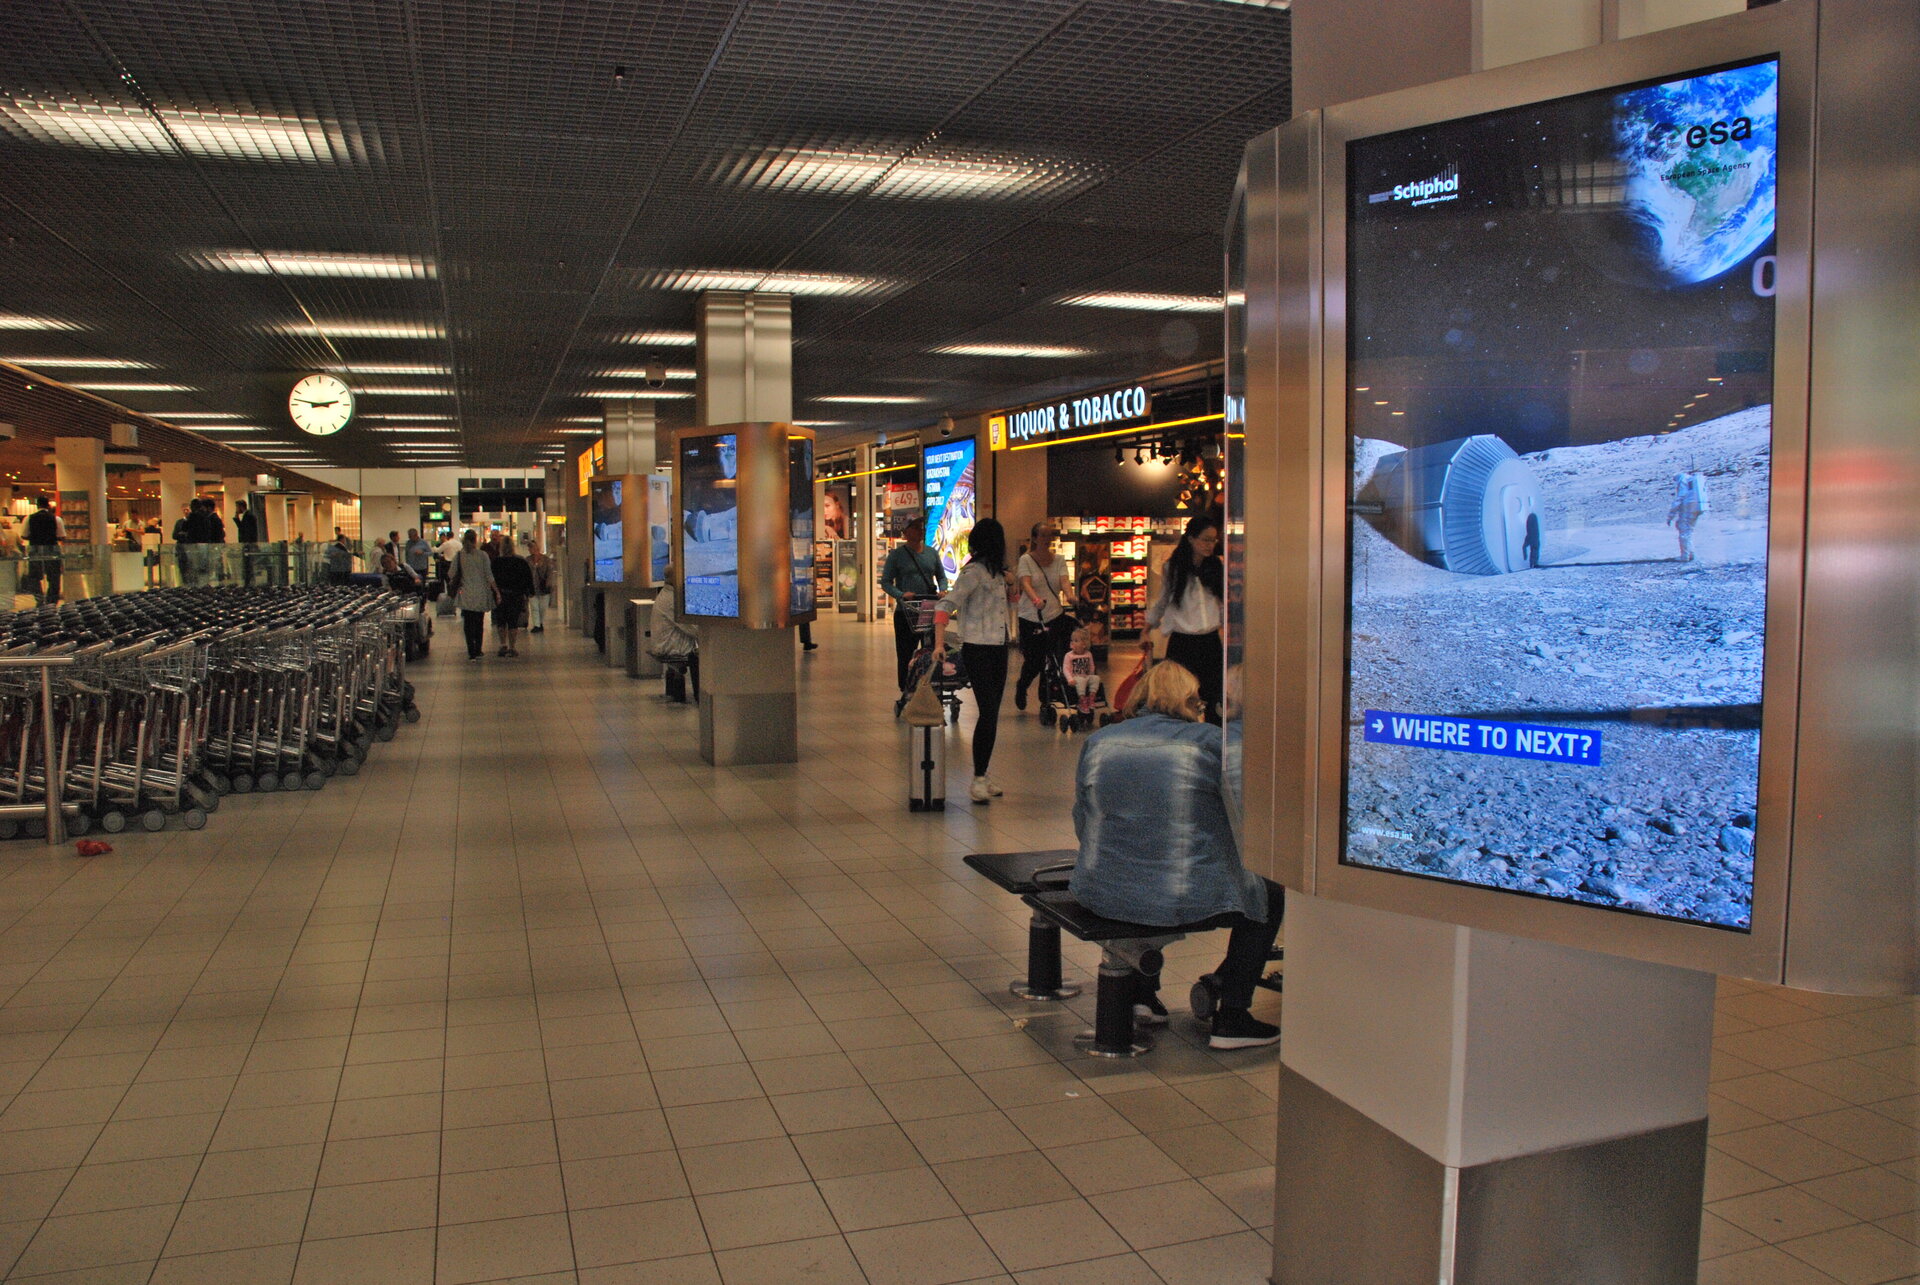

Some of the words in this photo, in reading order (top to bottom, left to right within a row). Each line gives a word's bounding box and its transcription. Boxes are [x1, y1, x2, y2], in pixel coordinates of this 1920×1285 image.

[1686, 116, 1752, 148] esa
[1393, 173, 1458, 200] Schiphol
[1660, 171, 1696, 182] European
[1697, 167, 1720, 178] Space
[1722, 162, 1752, 172] Agency
[1008, 410, 1056, 441] LIQUOR
[1059, 403, 1070, 428] &
[1072, 386, 1146, 427] TOBACCO
[1391, 716, 1470, 748] WHERE
[1478, 725, 1508, 751] TO
[1516, 729, 1593, 758] NEXT?
[1361, 826, 1414, 842] www.esa.int
